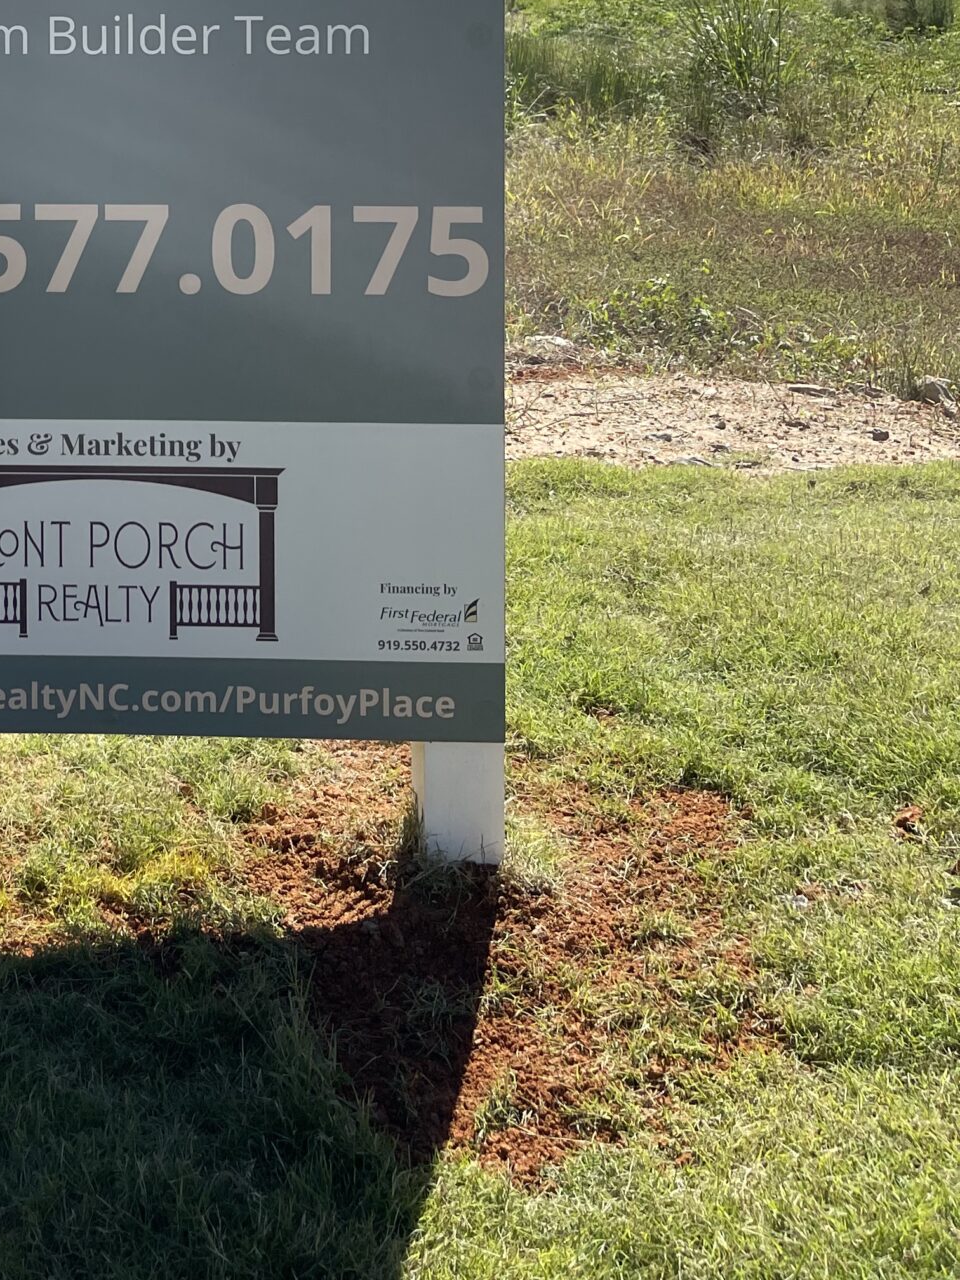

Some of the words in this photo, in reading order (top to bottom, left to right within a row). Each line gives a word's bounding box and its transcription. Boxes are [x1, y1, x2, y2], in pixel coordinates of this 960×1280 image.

[48, 13, 220, 56] Builder
[234, 15, 370, 55] Team
[27, 433, 53, 456] &
[60, 431, 202, 463] Marketing
[209, 433, 242, 463] by
[89, 521, 245, 570] PORCH
[38, 584, 161, 627] REALTY
[380, 583, 441, 596] Financing
[443, 583, 458, 597] by
[380, 606, 410, 620] First
[410, 610, 462, 623] Federal
[378, 640, 460, 652] 919.550.4732
